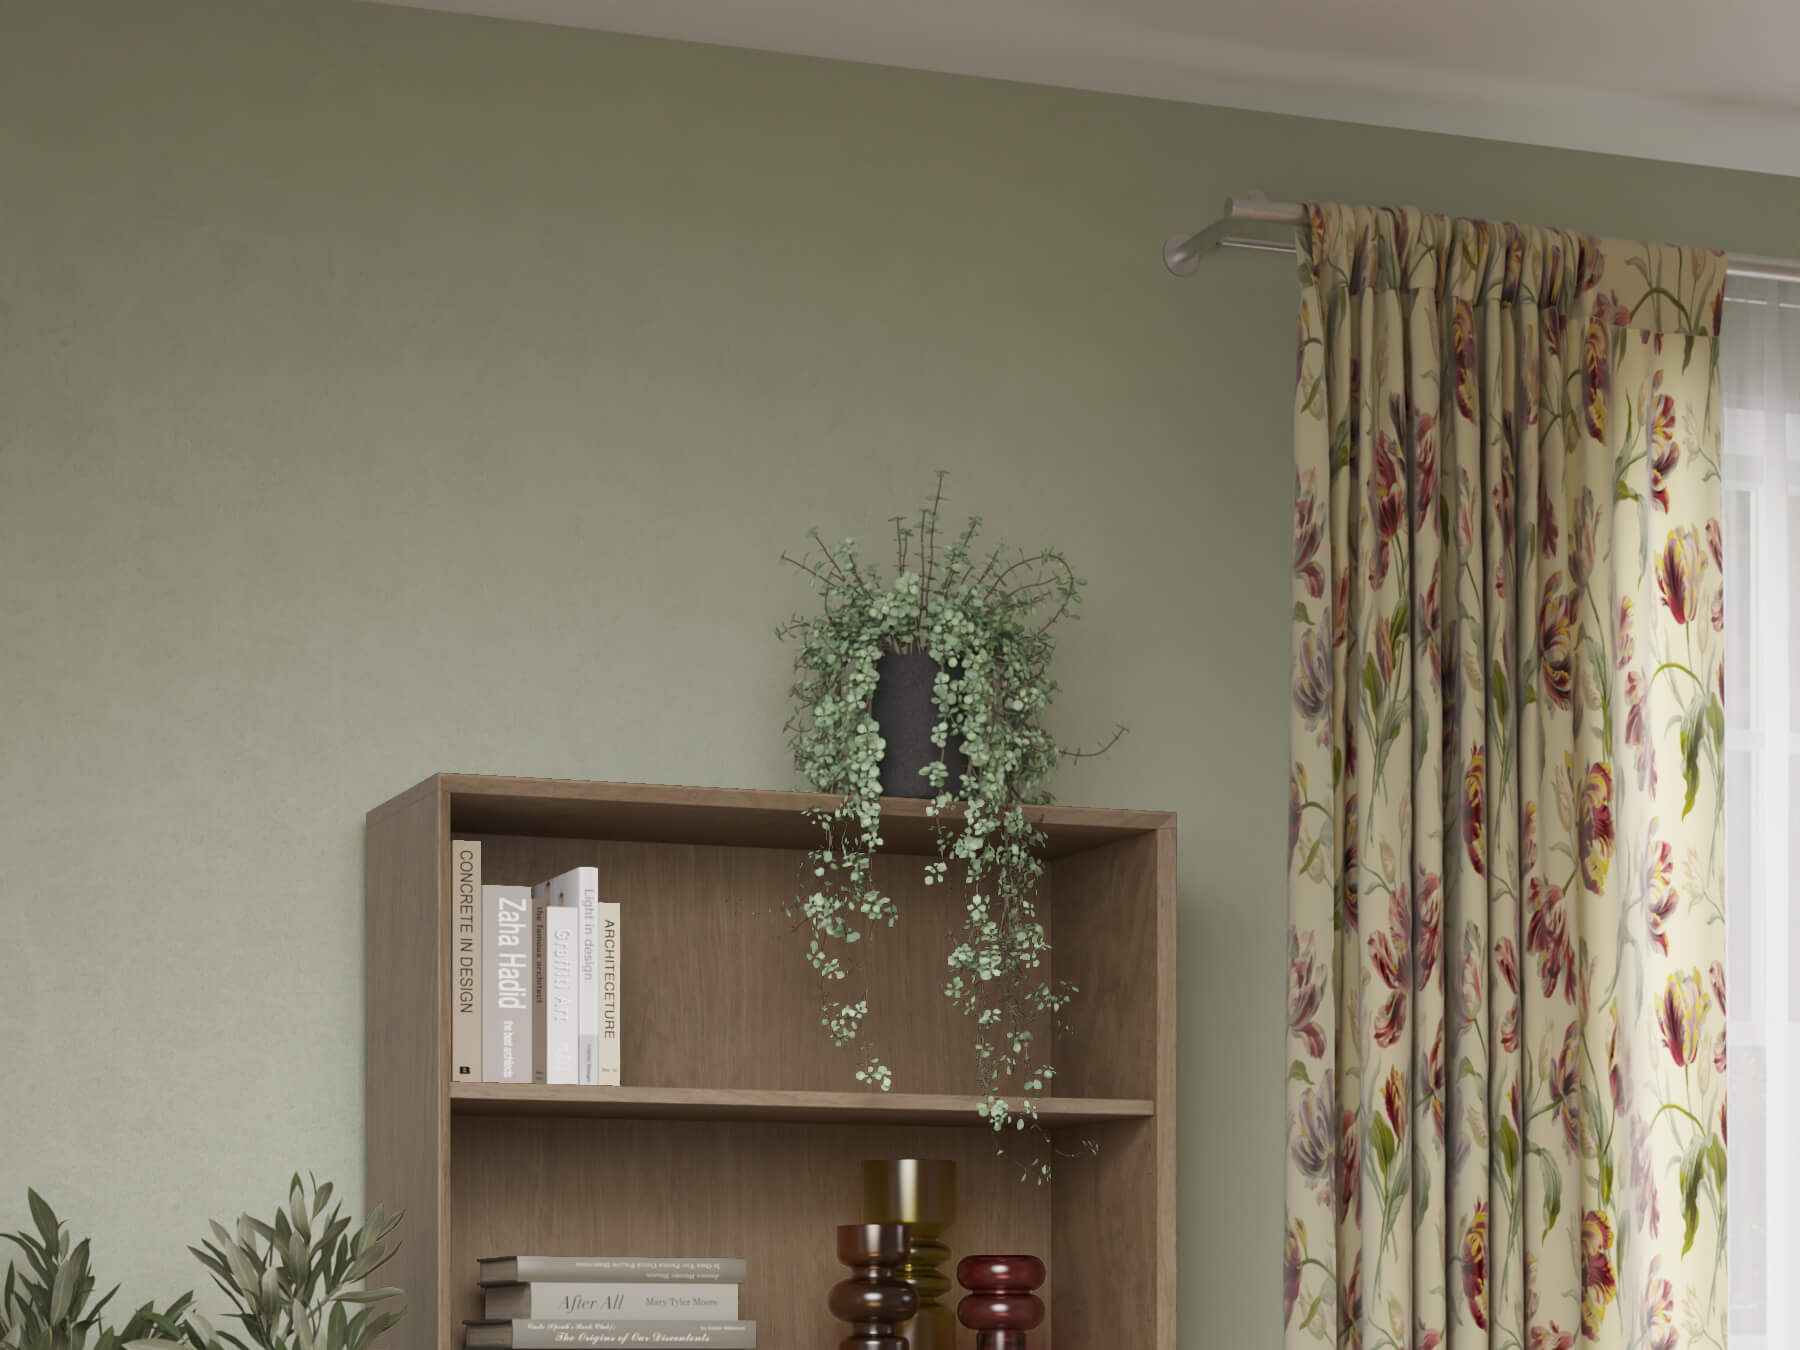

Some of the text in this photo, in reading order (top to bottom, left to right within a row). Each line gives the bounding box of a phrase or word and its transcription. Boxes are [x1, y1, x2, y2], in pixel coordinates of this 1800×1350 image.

[459, 849, 474, 1015] CONCRETE IN DESIGN
[497, 896, 528, 1009] Zaha Hadid
[582, 938, 595, 982] design
[559, 1294, 598, 1314] After
[601, 1294, 625, 1310] All
[554, 1331, 572, 1343] The
